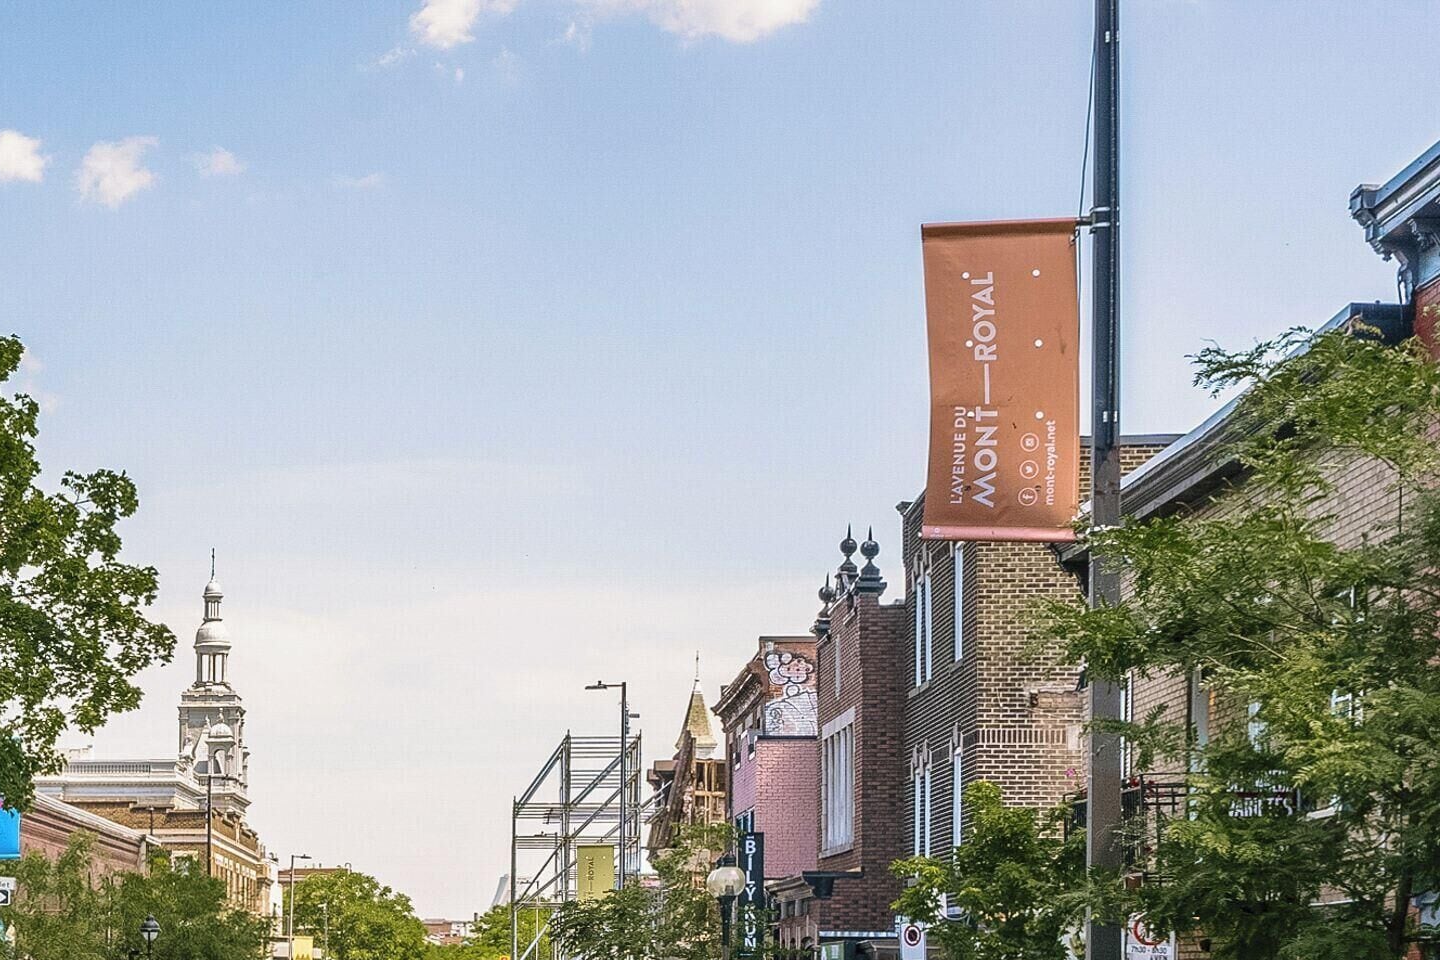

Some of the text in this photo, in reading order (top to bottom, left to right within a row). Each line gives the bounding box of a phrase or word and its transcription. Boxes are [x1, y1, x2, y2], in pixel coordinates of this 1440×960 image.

[950, 406, 966, 504] L'AVENUE DU
[1045, 420, 1058, 506] mont-royal.net
